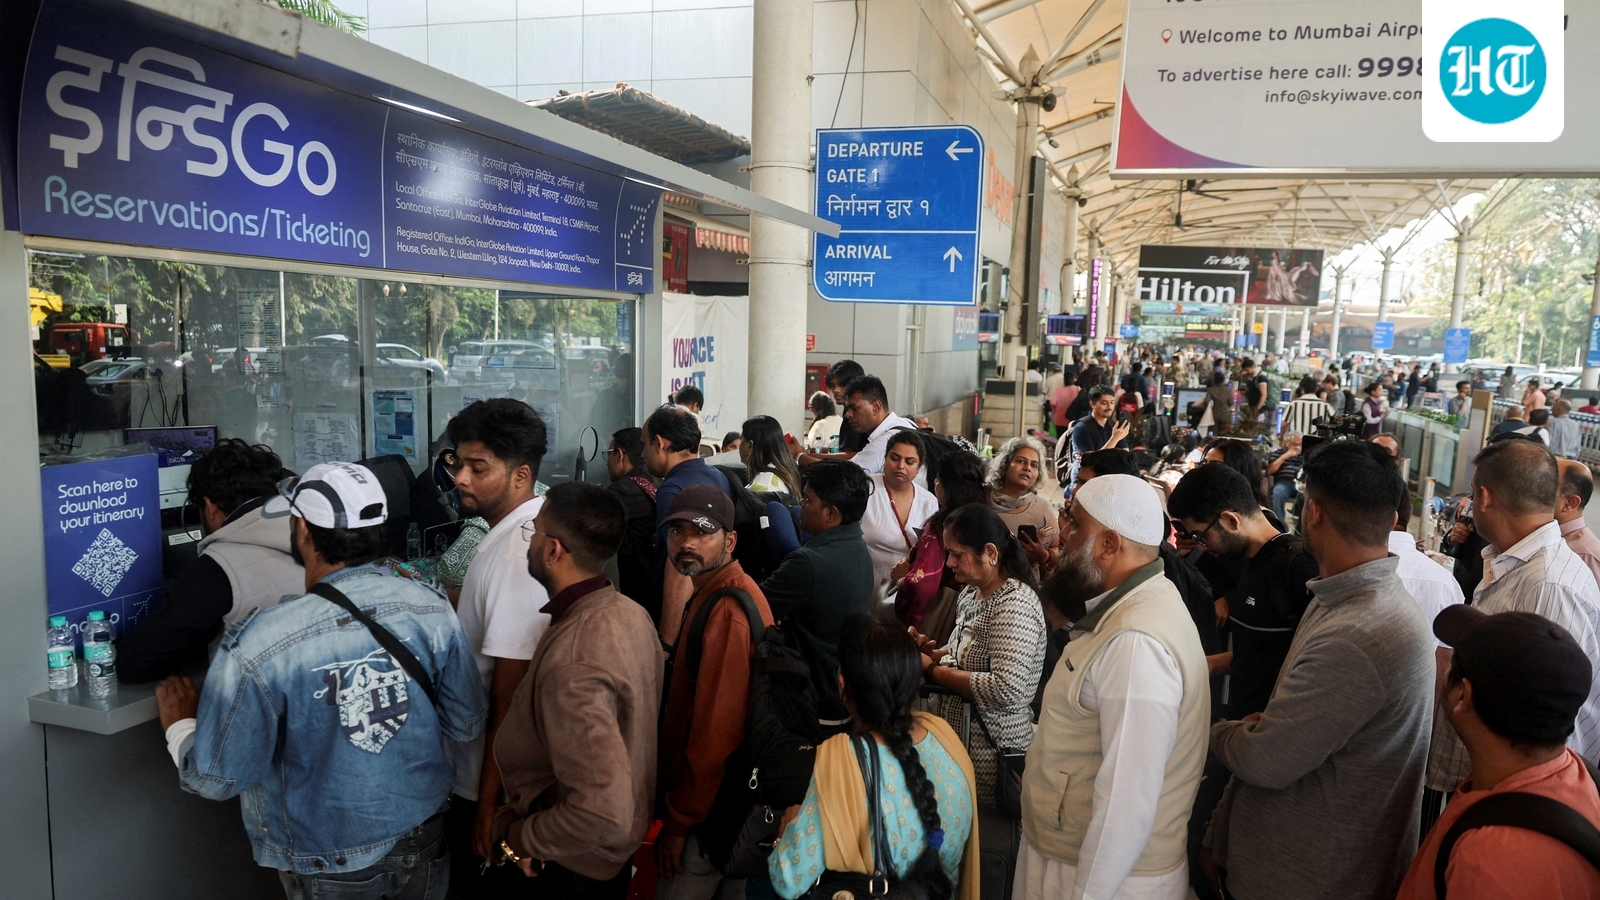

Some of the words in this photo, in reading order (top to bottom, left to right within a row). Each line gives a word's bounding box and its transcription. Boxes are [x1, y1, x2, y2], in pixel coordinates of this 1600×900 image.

[1180, 29, 1262, 44] Welcome
[1268, 28, 1287, 40] to
[1294, 22, 1372, 40] Mumbai
[1378, 22, 1422, 40] Airp
[1158, 69, 1176, 82] To
[1182, 67, 1263, 82] advertise
[1270, 66, 1308, 80] here
[1315, 64, 1352, 78] call:
[828, 142, 924, 158] DEPARTURE
[826, 168, 866, 182] GATE
[871, 168, 878, 182] 1
[396, 181, 414, 195] Local
[416, 186, 440, 200] Office:
[464, 196, 498, 212] InterGlobe
[498, 203, 521, 216] Aviation
[522, 208, 542, 222] Limited,
[542, 212, 561, 224] Terminal
[396, 198, 432, 214] Santacruz
[432, 205, 454, 220] (East),
[456, 210, 482, 224] Mumbai,
[482, 214, 520, 230] Maharashtra
[826, 194, 881, 216] निर्गमन
[886, 200, 913, 219] द्वार
[920, 200, 929, 216] १
[44, 175, 371, 258] Reservations/Ticketing
[396, 226, 432, 240] Registered
[434, 232, 454, 244] Office:
[454, 235, 476, 248] IndiGo,
[476, 238, 505, 250] InterGlobe
[506, 242, 526, 253] Aviation
[544, 248, 558, 260] Upper
[559, 251, 576, 262] Ground
[586, 255, 600, 265] Thapar
[396, 241, 420, 254] House,
[421, 244, 438, 256] Gate
[439, 246, 449, 258] No.
[450, 248, 456, 259] 2,
[482, 252, 498, 265] Wing,
[498, 255, 508, 264] 124
[508, 256, 529, 268] Janpath,
[530, 260, 540, 268] New
[541, 260, 552, 270] Delhi
[824, 244, 892, 259] ARRIVAL
[824, 270, 876, 288] आगमन
[1134, 276, 1236, 304] Hilton
[58, 484, 91, 499] Scan
[92, 479, 123, 494] here
[125, 477, 138, 488] to
[59, 492, 127, 515] download
[60, 514, 90, 533] your
[93, 506, 144, 524] itinerary
